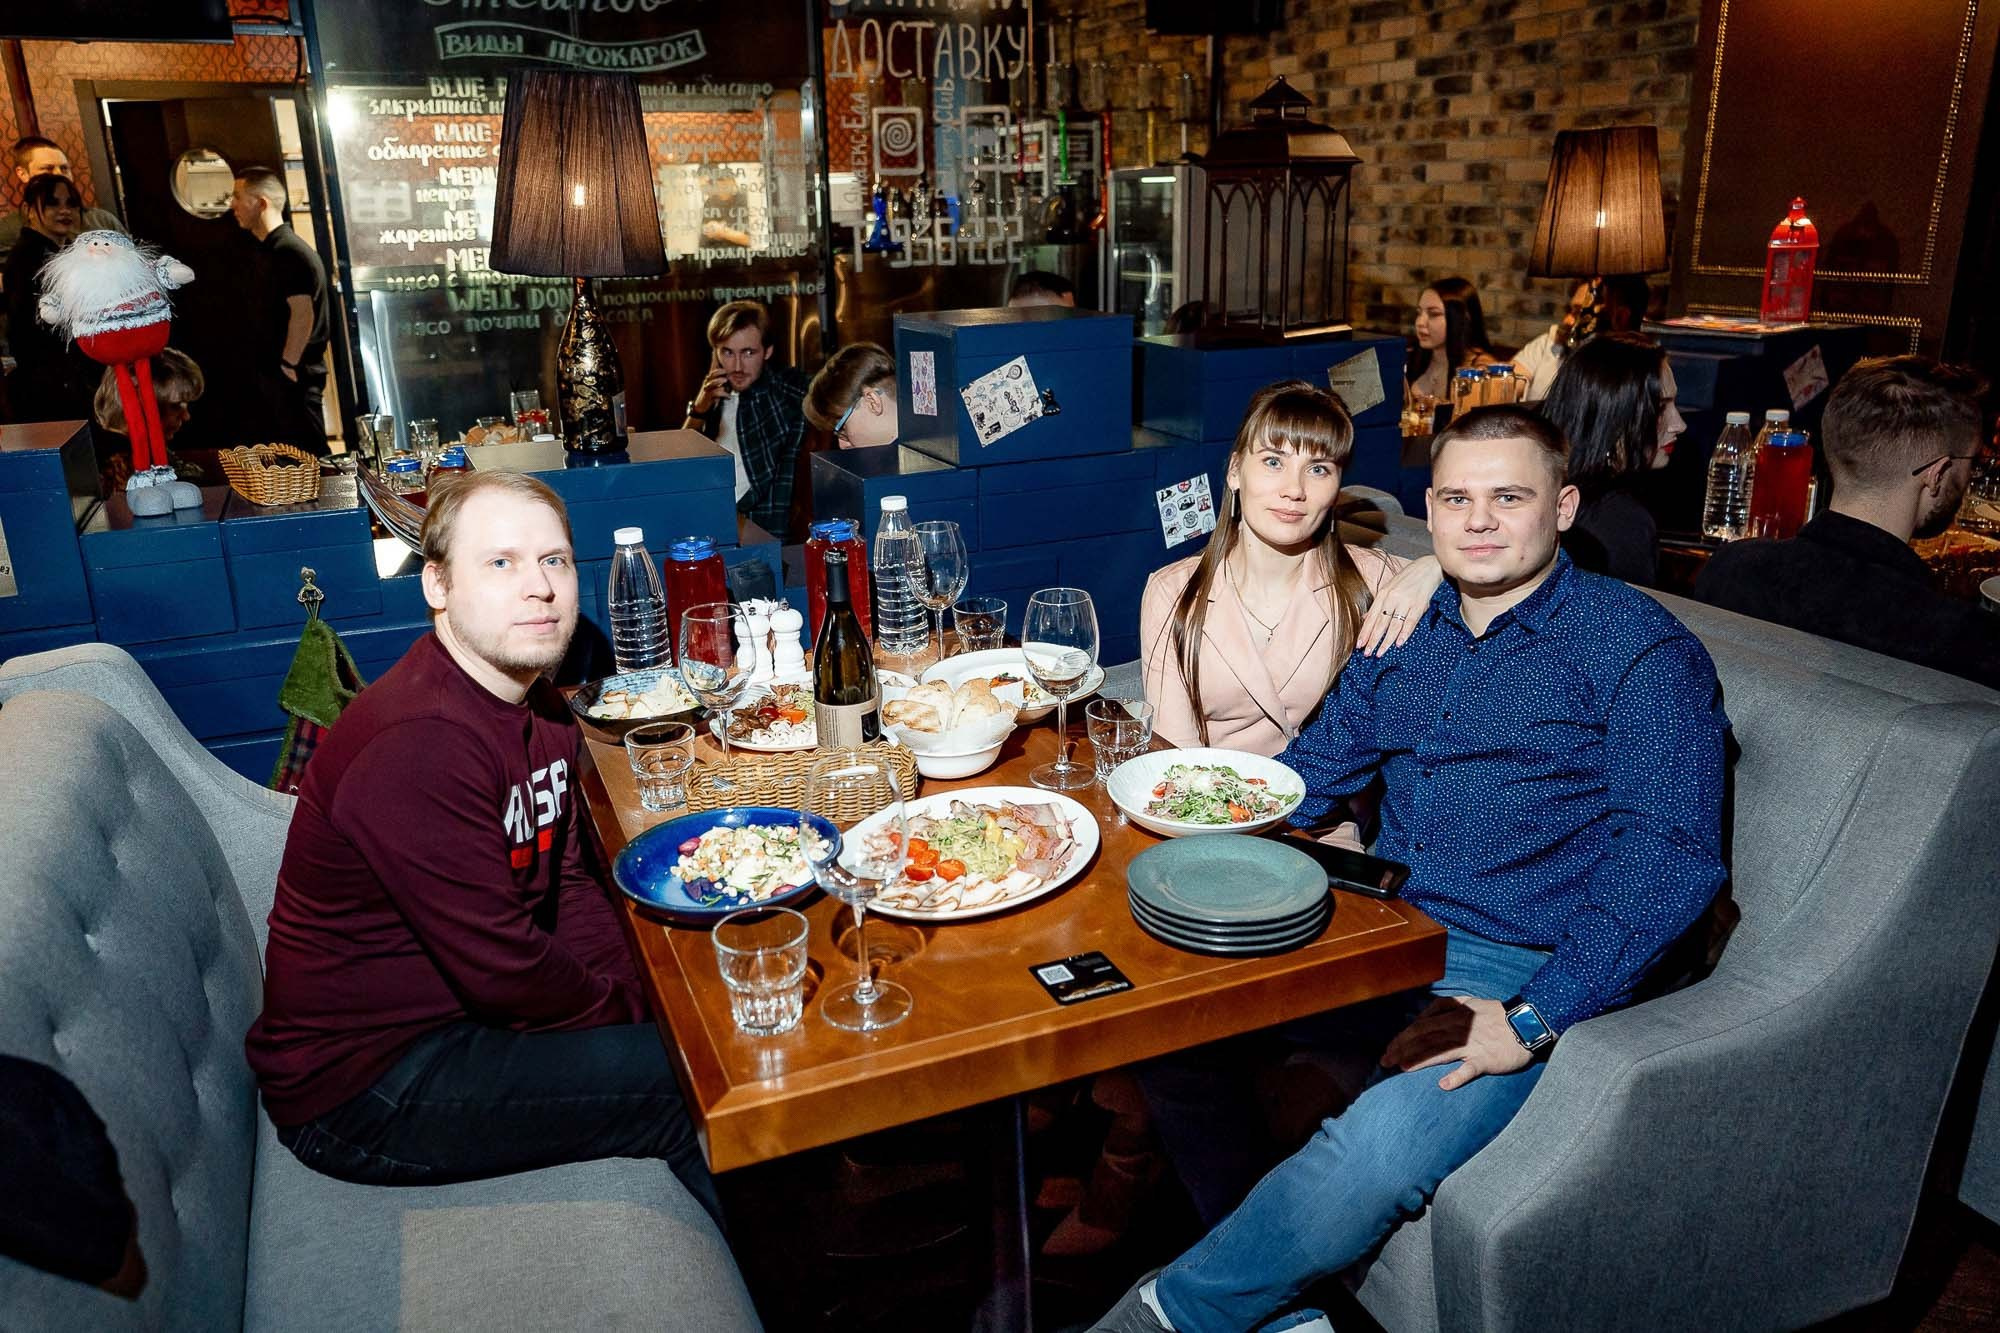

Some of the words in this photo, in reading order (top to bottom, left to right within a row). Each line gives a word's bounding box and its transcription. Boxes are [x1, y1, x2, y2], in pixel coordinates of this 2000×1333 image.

[446, 35, 523, 53] ВИДЫ
[549, 37, 693, 66] ПРОЖАРОК
[830, 18, 1026, 81] ДОСТАВКУ
[430, 78, 484, 98] BLUE
[434, 123, 492, 142] RARE
[448, 288, 520, 312] WELL
[527, 287, 575, 311] DON
[464, 313, 540, 333] почти
